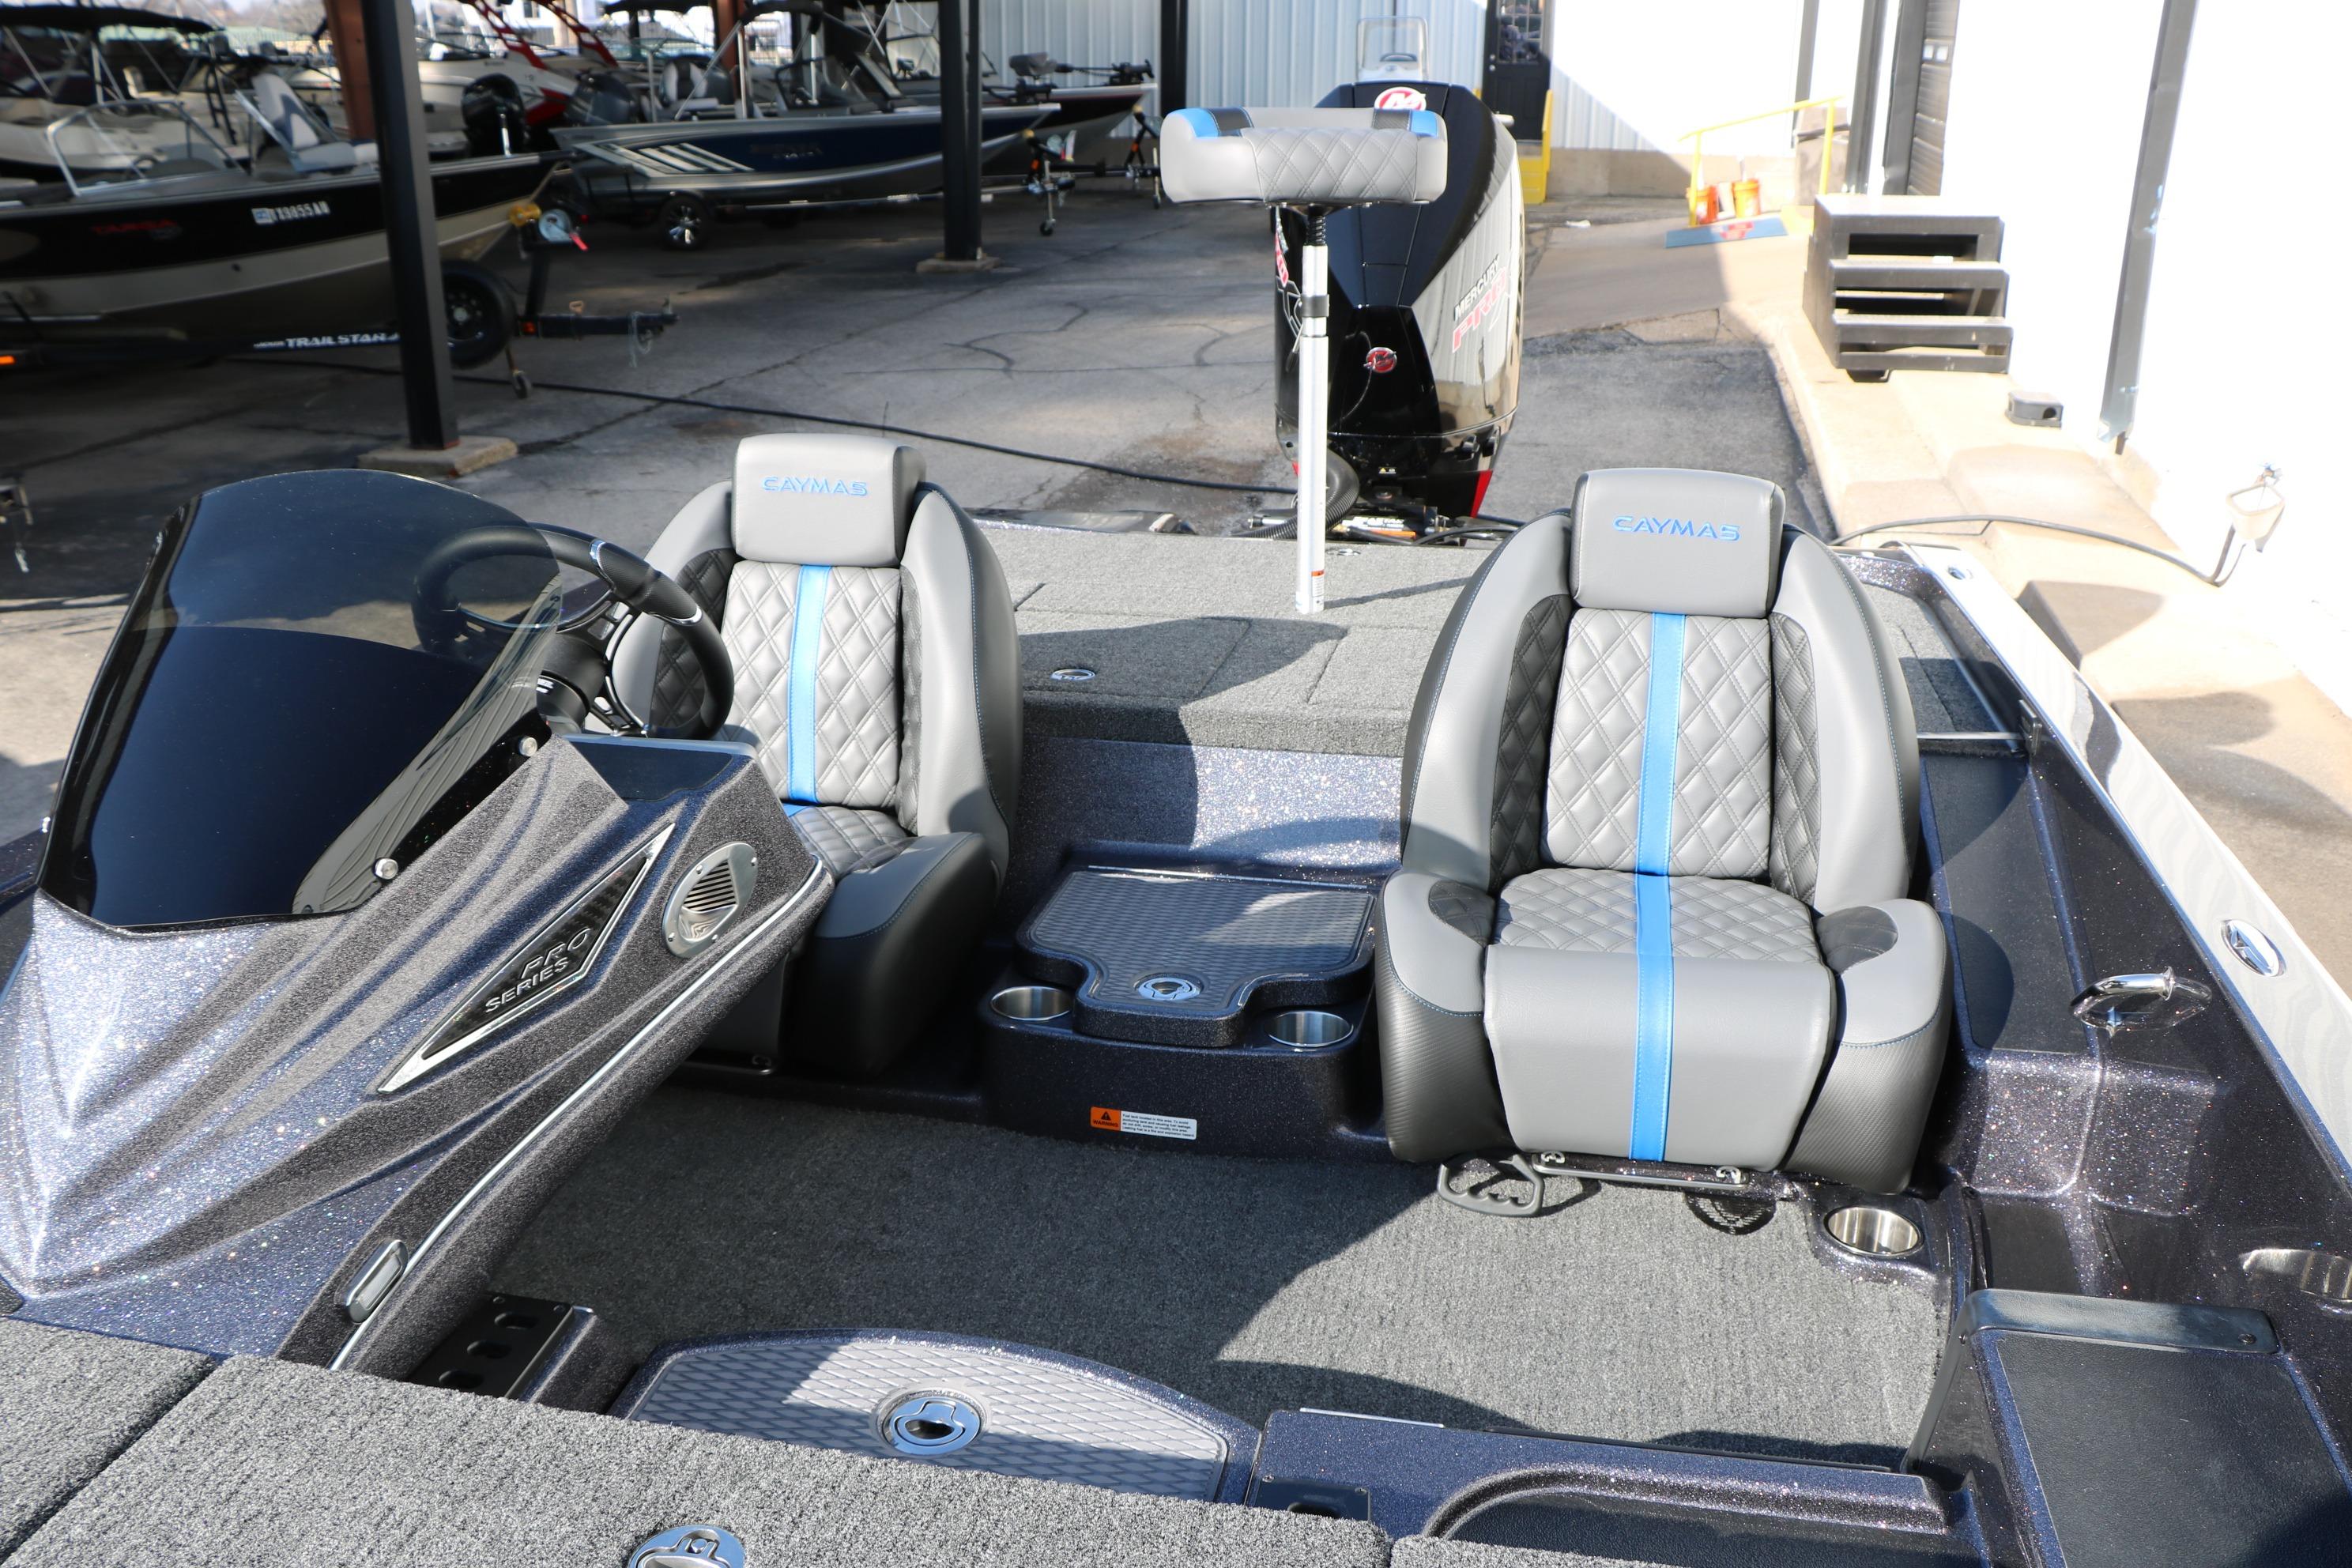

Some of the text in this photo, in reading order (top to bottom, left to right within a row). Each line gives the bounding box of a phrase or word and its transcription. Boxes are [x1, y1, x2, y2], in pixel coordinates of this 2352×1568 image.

[1453, 253, 1499, 322] MERCURY
[285, 336, 336, 348] TRAIL
[761, 476, 869, 496] CAYMAS
[1612, 515, 1741, 541] CAYMAS
[521, 927, 591, 979] PRO
[485, 956, 569, 1013] SERIES
[1093, 1119, 1119, 1128] WARNING
